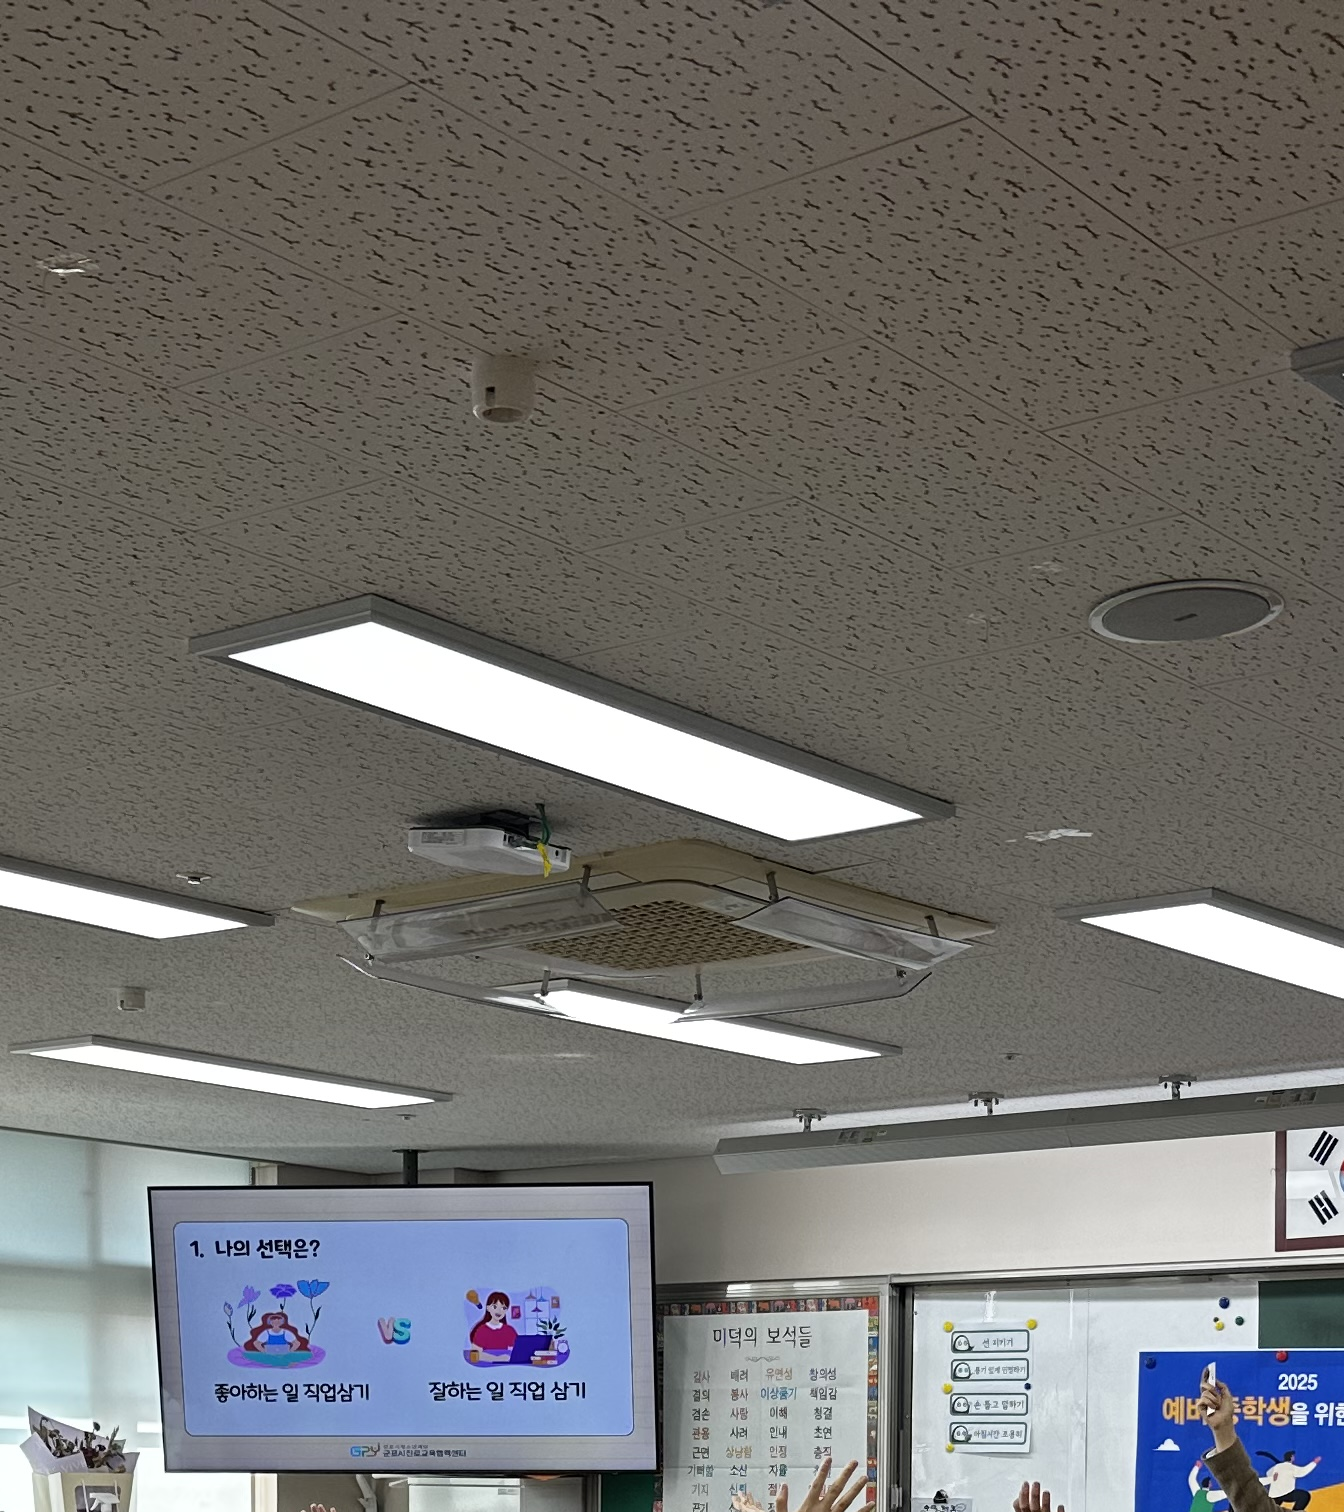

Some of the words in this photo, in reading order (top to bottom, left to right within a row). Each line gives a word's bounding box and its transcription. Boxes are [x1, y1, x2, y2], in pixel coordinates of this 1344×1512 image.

[189, 1240, 205, 1259] 1.
[215, 1239, 250, 1258] 나의
[256, 1239, 321, 1260] 선택은?
[377, 1317, 412, 1345] VS
[713, 1327, 757, 1349] 미덕의
[766, 1326, 812, 1348] 보석들
[765, 1367, 793, 1381] 유연성
[809, 1367, 837, 1381] 창의성
[1278, 1373, 1318, 1391] 2025
[214, 1383, 278, 1403] 좋아하는
[282, 1383, 299, 1403] 일
[429, 1381, 483, 1401] 잘하는
[486, 1381, 505, 1402] 일
[509, 1381, 546, 1402] 직업
[550, 1380, 587, 1401] 삼기
[809, 1387, 837, 1401] 책임감
[692, 1408, 710, 1421] 겸손
[730, 1407, 748, 1420] 사랑
[769, 1406, 788, 1419] 이해
[813, 1406, 833, 1420] 청결
[729, 1426, 748, 1439] 사려
[769, 1426, 788, 1439] 인내
[813, 1426, 833, 1439] 초연
[692, 1447, 710, 1459] 근면
[769, 1445, 787, 1459] 인정
[730, 1464, 748, 1477] 소신
[691, 1483, 709, 1496] 기지
